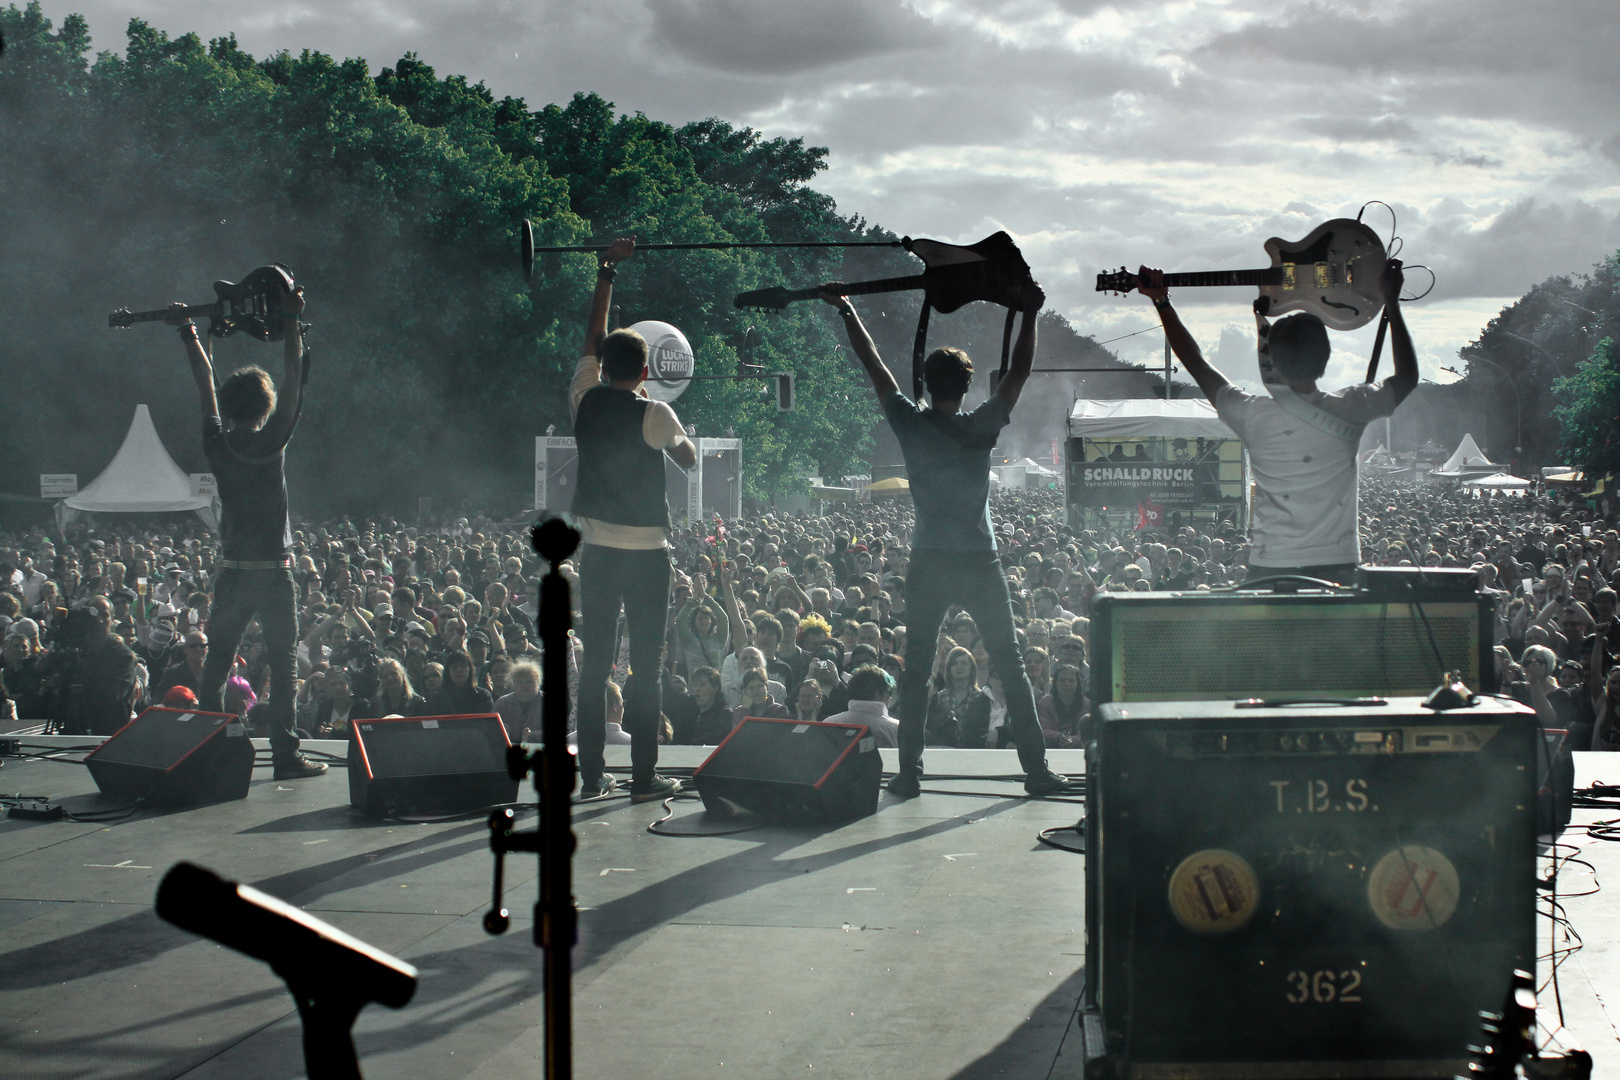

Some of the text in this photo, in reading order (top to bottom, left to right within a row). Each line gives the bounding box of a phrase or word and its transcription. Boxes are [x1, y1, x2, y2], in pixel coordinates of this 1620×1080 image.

[662, 349, 688, 360] LUCKY
[660, 360, 688, 372] STRIKE
[547, 438, 577, 446] EINFACH
[1084, 468, 1194, 481] SCHALLDRUCK
[1269, 779, 1379, 813] T.B.S.
[1287, 970, 1362, 1003] 362
